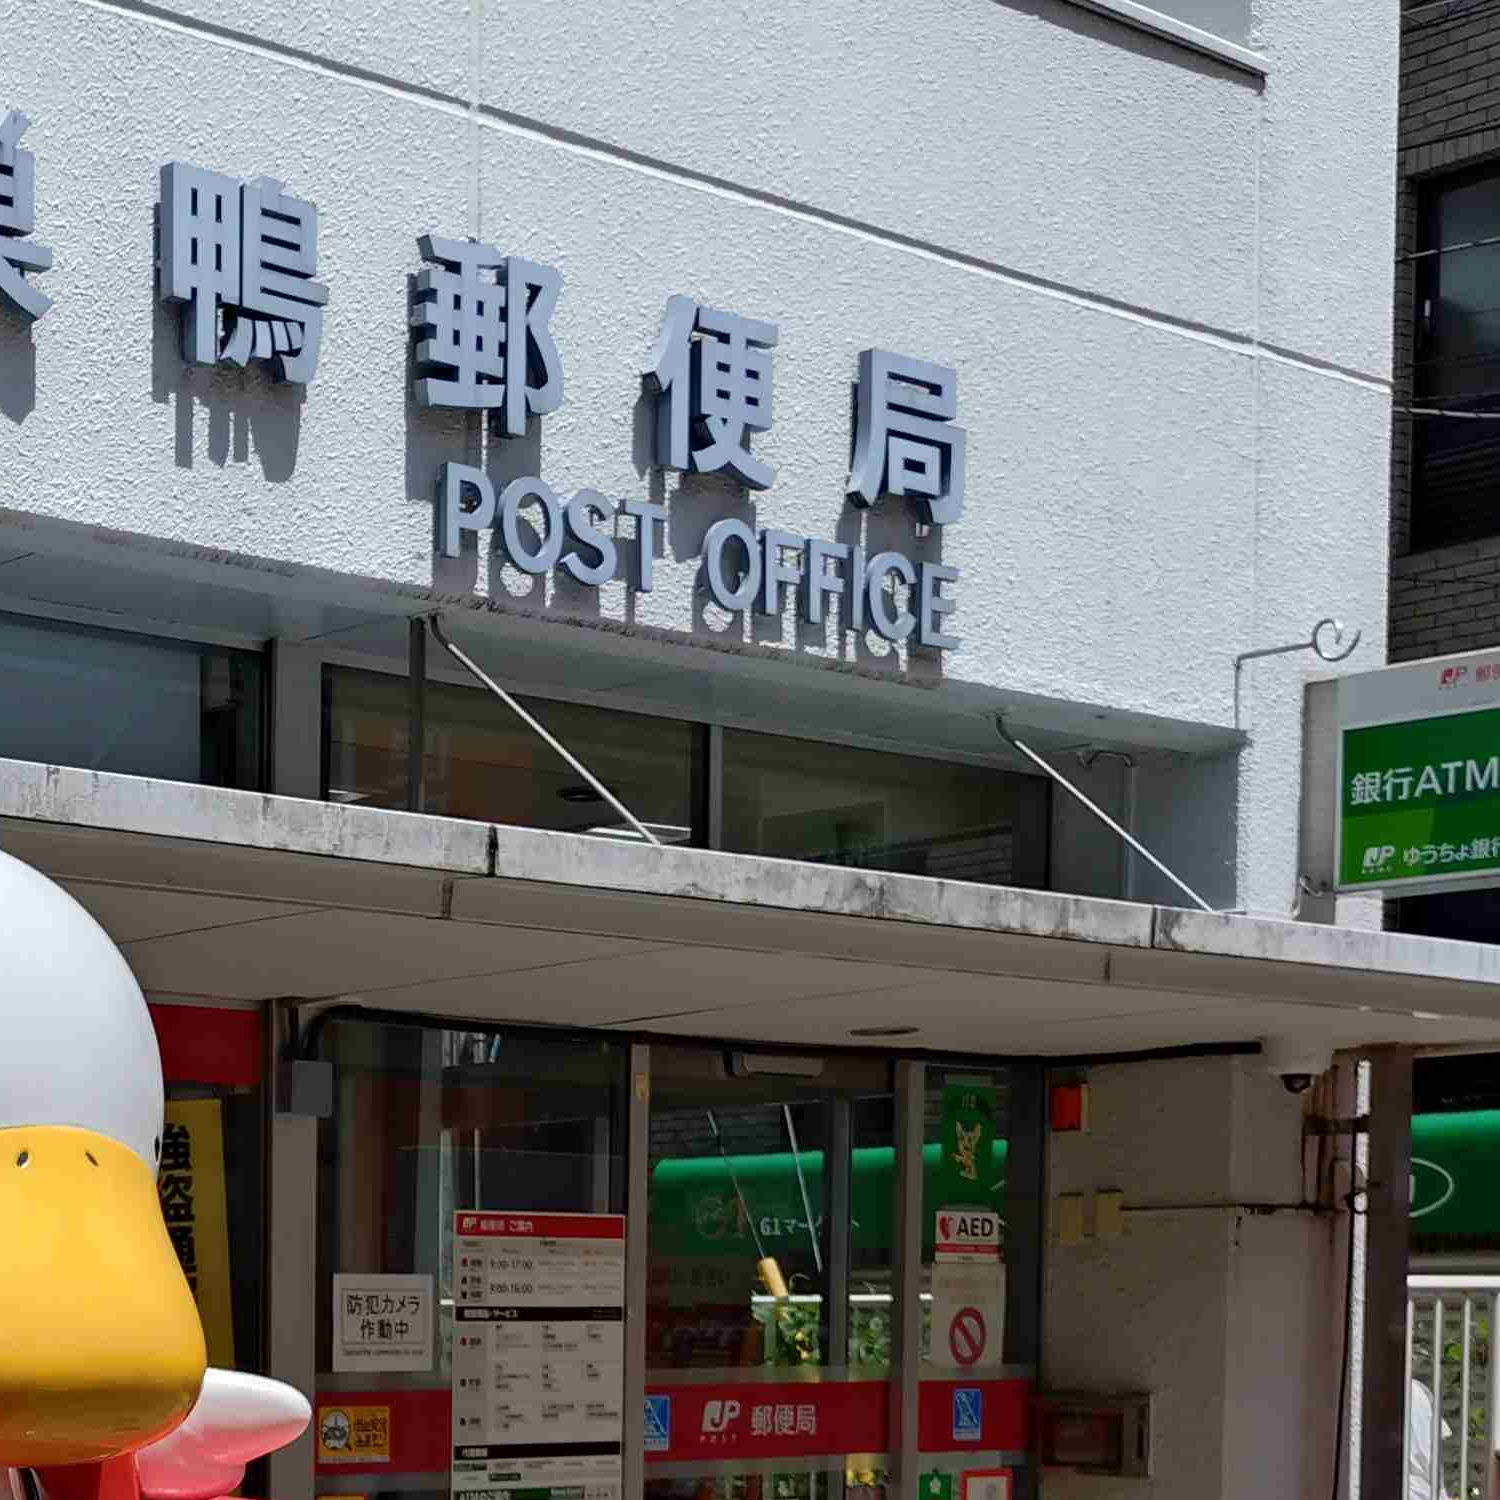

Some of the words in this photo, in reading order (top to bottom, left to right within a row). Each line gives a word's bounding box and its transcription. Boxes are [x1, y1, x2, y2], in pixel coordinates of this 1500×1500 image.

[438, 461, 665, 592] POST
[706, 517, 960, 652] OFFICE
[1350, 757, 1500, 806] 銀行ATM
[957, 1217, 993, 1238] AED
[346, 1294, 421, 1316] 防犯カメラ
[360, 1319, 409, 1340] 作動中
[751, 1403, 817, 1437] 郵便局
